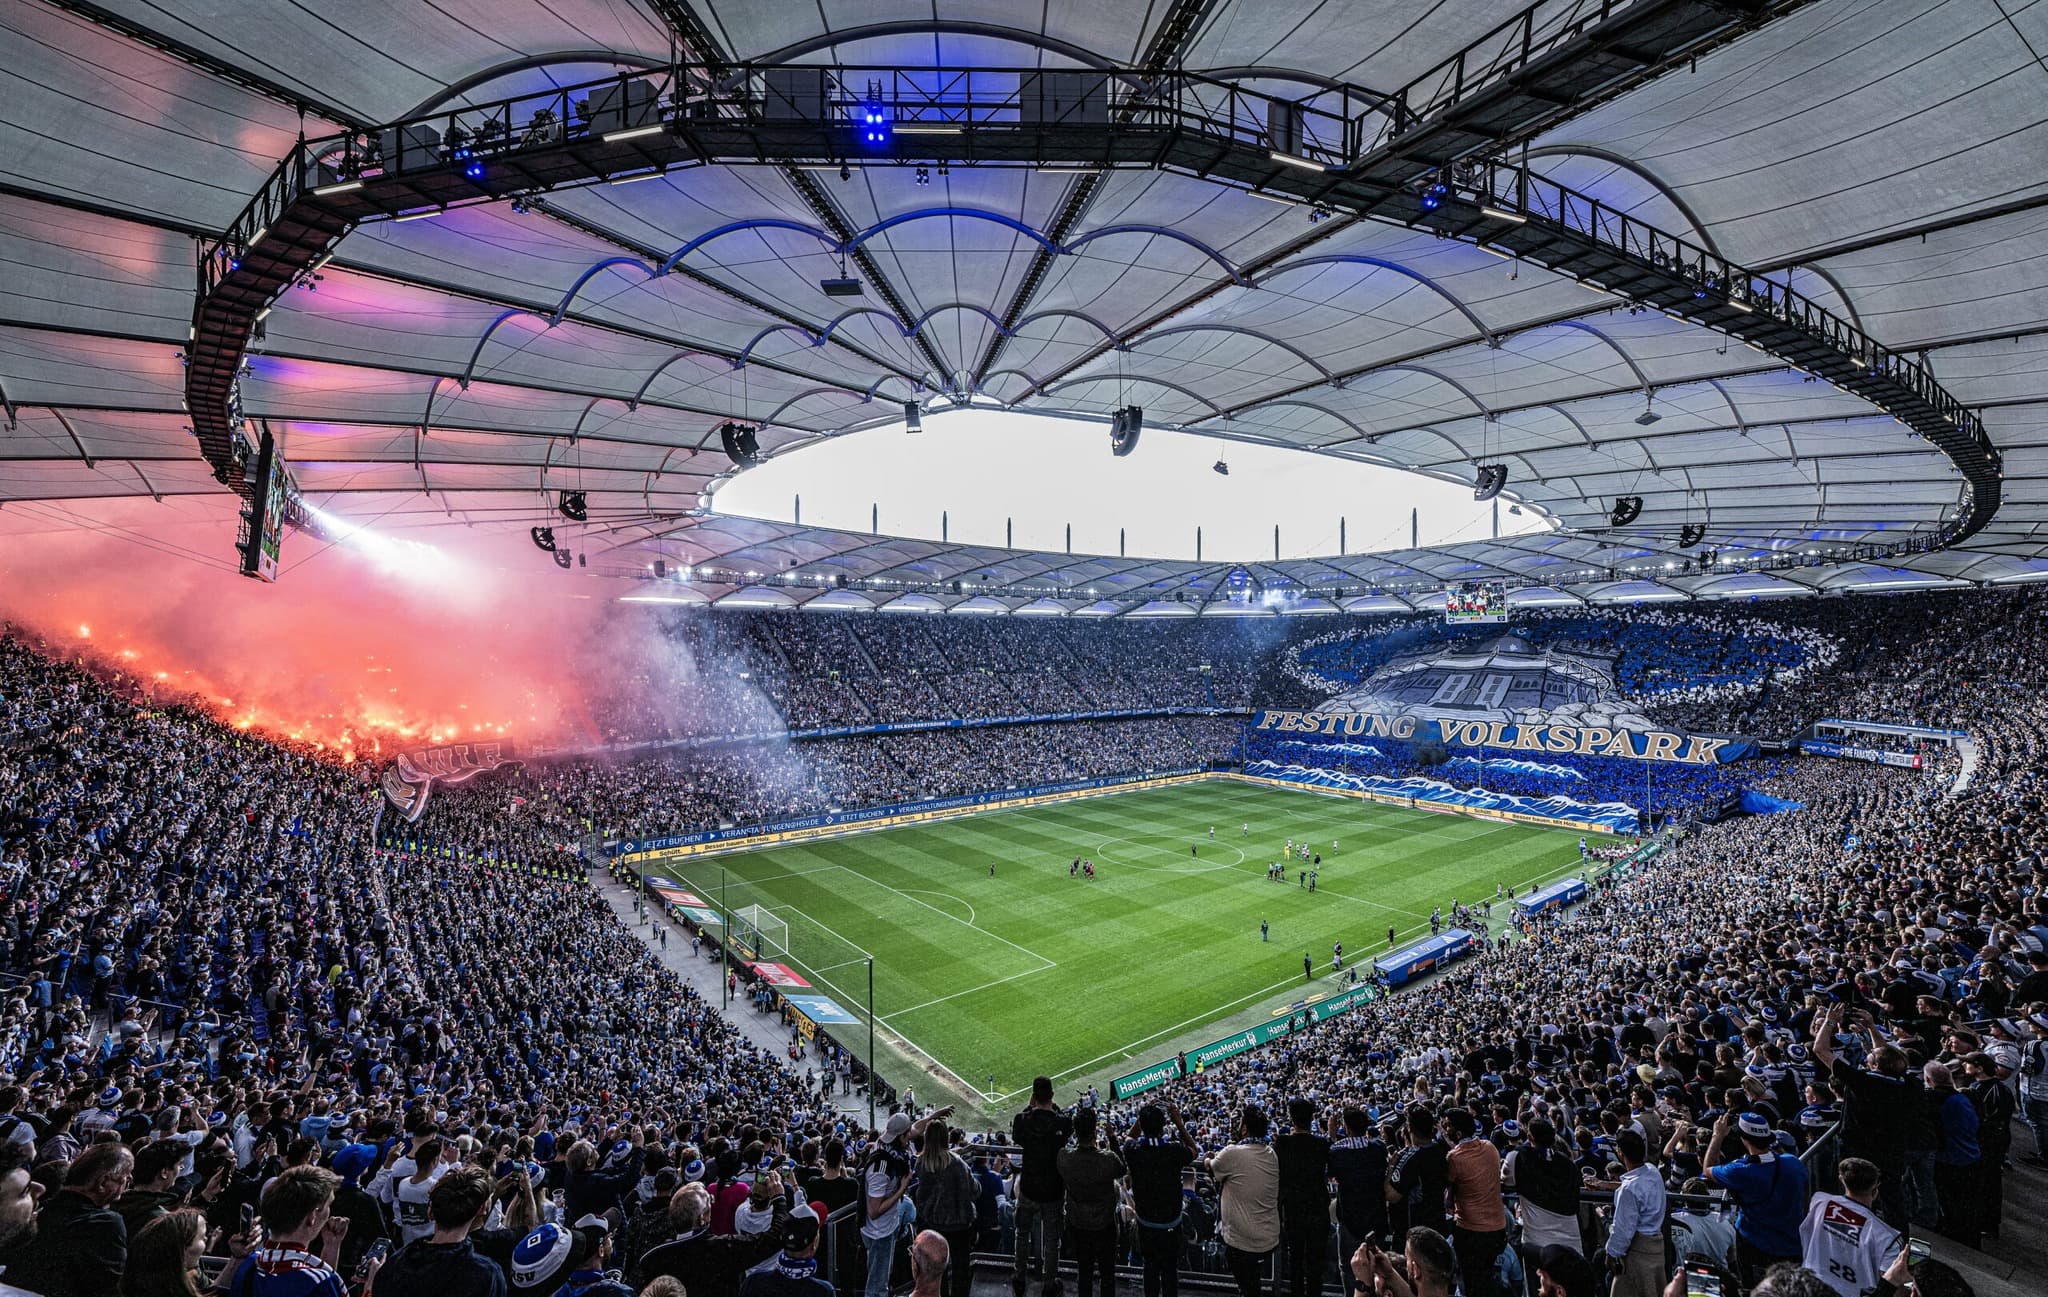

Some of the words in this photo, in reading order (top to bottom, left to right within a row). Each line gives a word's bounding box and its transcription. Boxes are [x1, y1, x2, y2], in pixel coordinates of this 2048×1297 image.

[1257, 710, 1417, 739] FESTUNG
[1438, 718, 1731, 764] VOLKSPARK
[898, 798, 974, 813] VERANSTALTUNGEN@HSV.DE
[839, 814, 858, 823] JETZT
[858, 810, 885, 820] BUCHEN!
[643, 839, 667, 849] JETZT
[1200, 1039, 1246, 1061] HanseMerkur
[1829, 1258, 1857, 1284] 28
